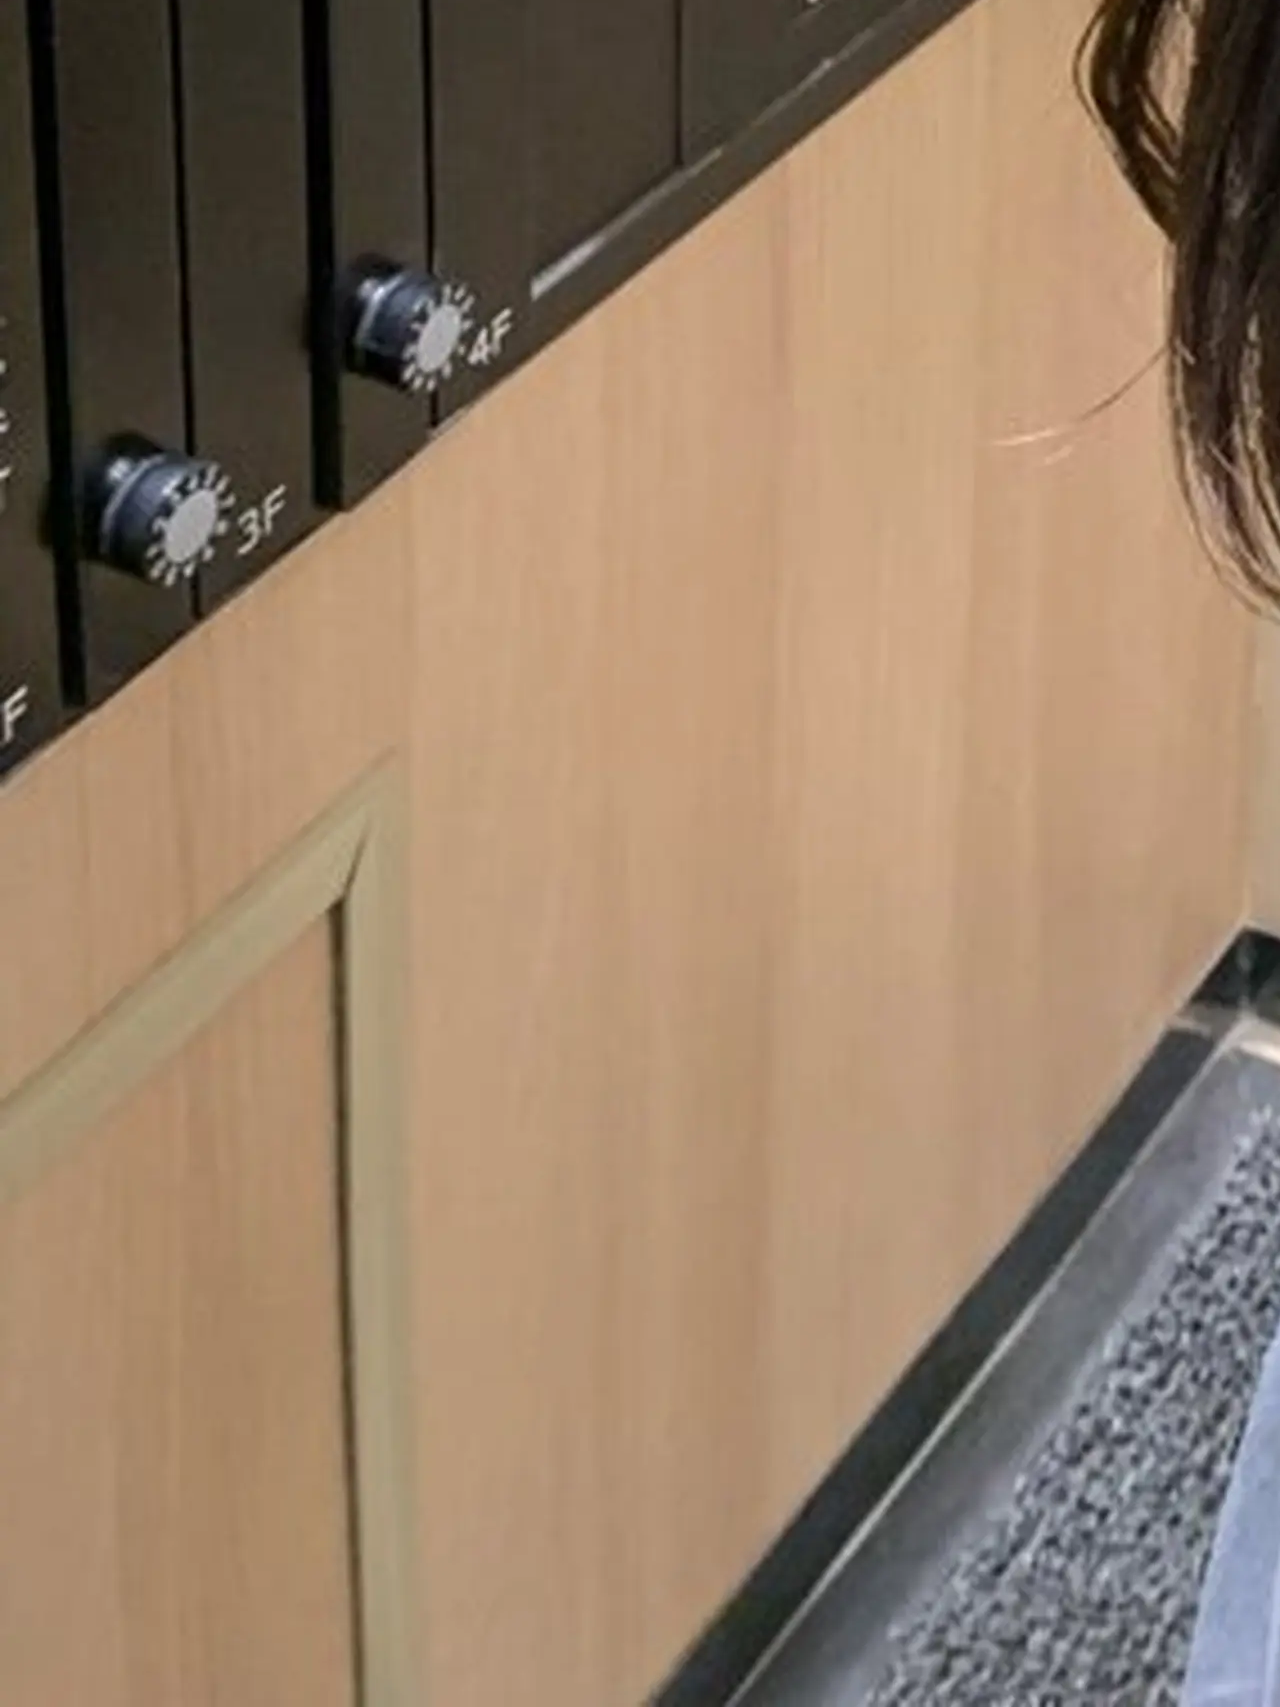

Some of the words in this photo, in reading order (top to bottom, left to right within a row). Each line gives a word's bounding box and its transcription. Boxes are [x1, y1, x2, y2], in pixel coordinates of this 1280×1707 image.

[467, 307, 513, 367] 4F
[236, 485, 286, 557] 3F
[0, 683, 28, 745] F
